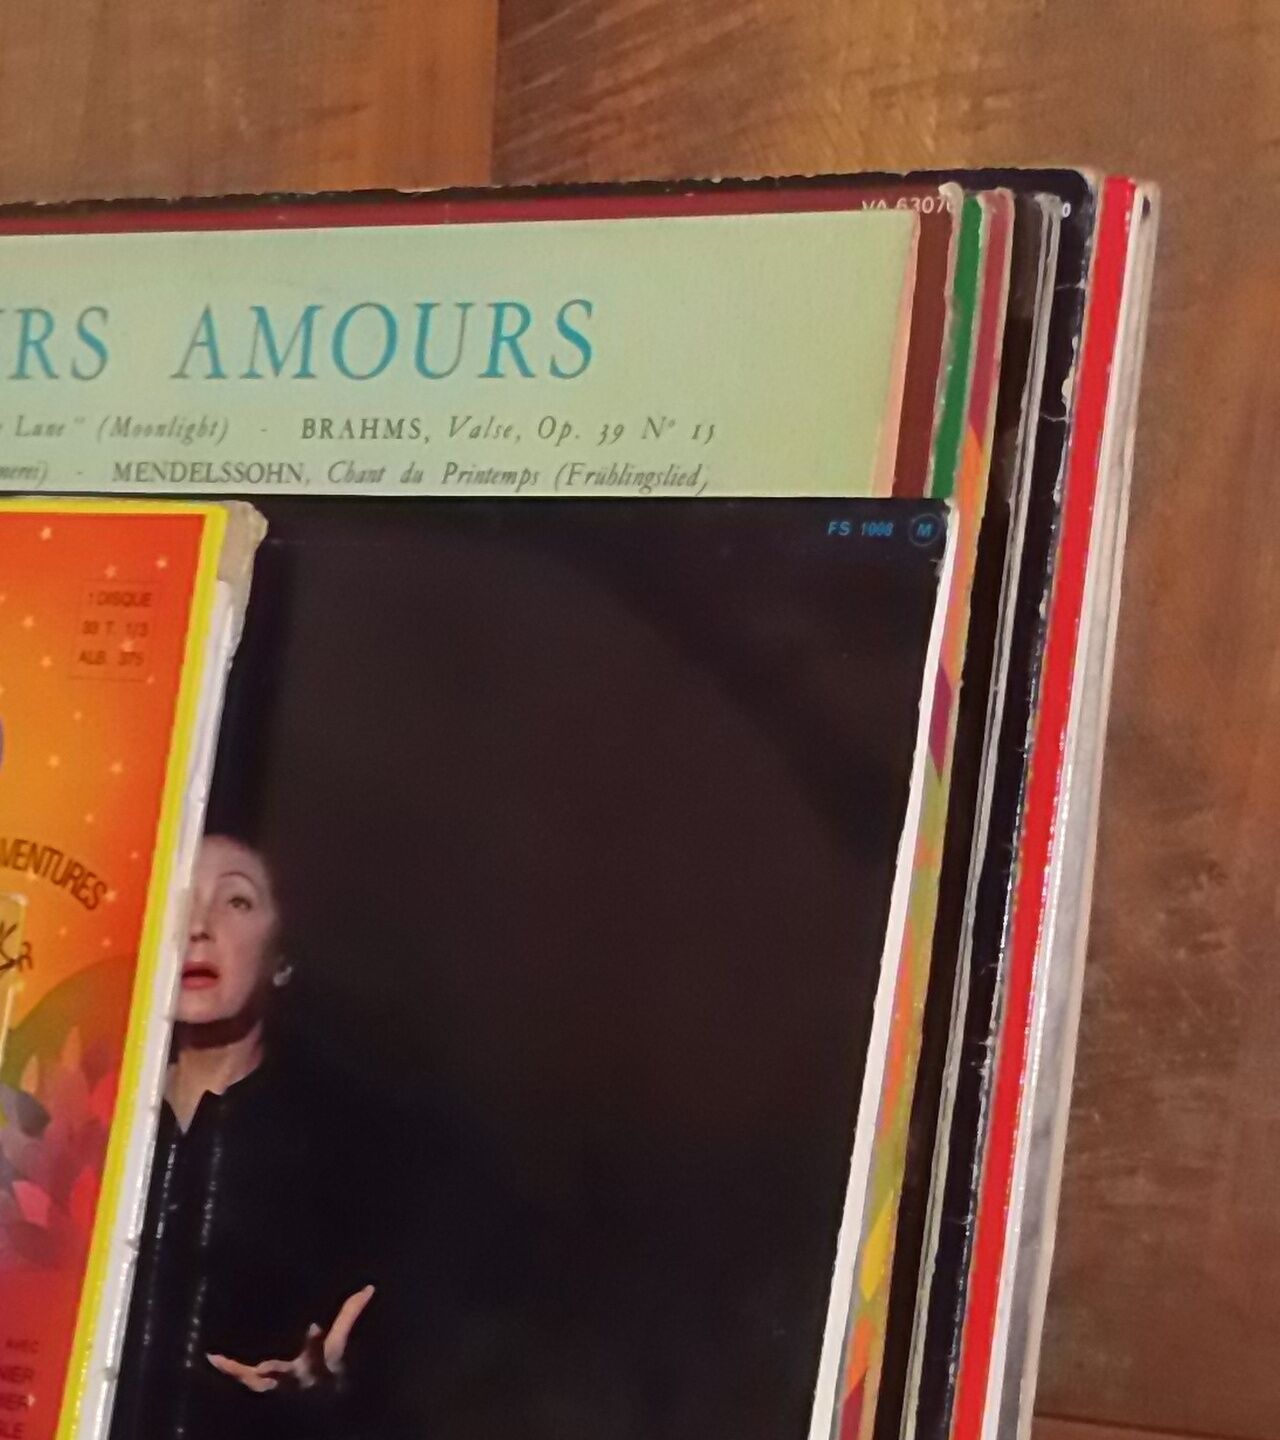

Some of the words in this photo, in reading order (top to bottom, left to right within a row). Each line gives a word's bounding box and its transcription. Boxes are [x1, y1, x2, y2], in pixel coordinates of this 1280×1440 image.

[171, 297, 597, 382] AMOURS
[97, 415, 229, 446] (Moonlight)
[301, 417, 430, 444] BRAHMS,
[447, 415, 522, 444] Valse,
[537, 415, 580, 447] Op.
[597, 423, 625, 446] 39
[691, 423, 716, 445] 15
[112, 461, 311, 486] MENDELSSOHN,
[327, 461, 386, 485] Chant
[400, 461, 424, 485] du
[441, 461, 540, 492] Printemps
[96, 590, 153, 607] DISQUE
